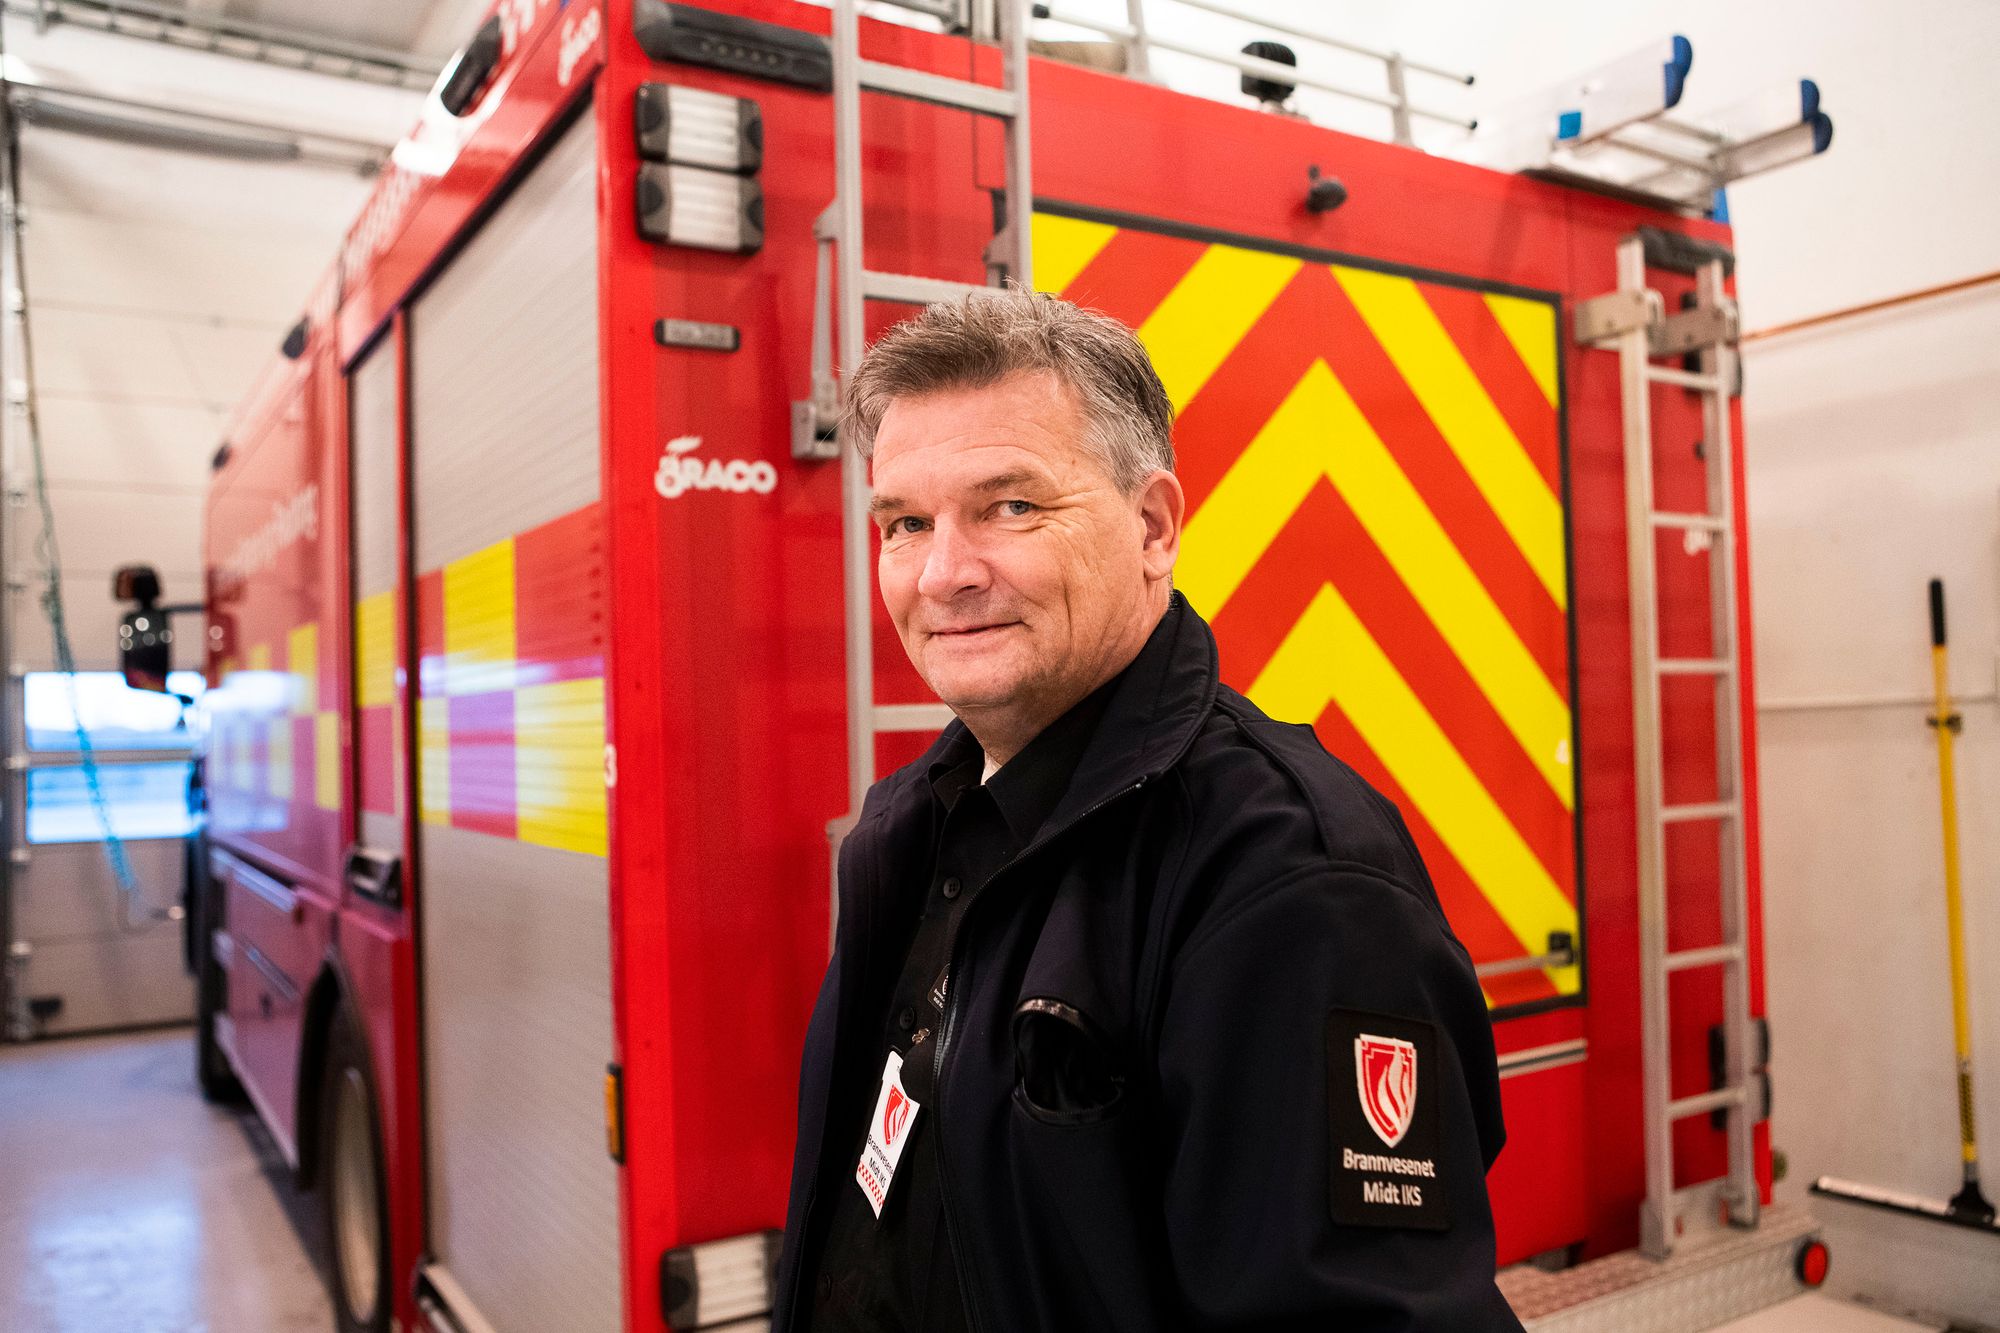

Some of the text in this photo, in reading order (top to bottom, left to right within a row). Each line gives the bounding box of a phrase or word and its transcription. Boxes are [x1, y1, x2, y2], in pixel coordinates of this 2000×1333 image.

[867, 1134, 894, 1177] Brannvesene
[868, 1156, 881, 1178] Midt
[1343, 1147, 1436, 1178] Brannvesenet
[1363, 1181, 1422, 1206] Midt IKS
